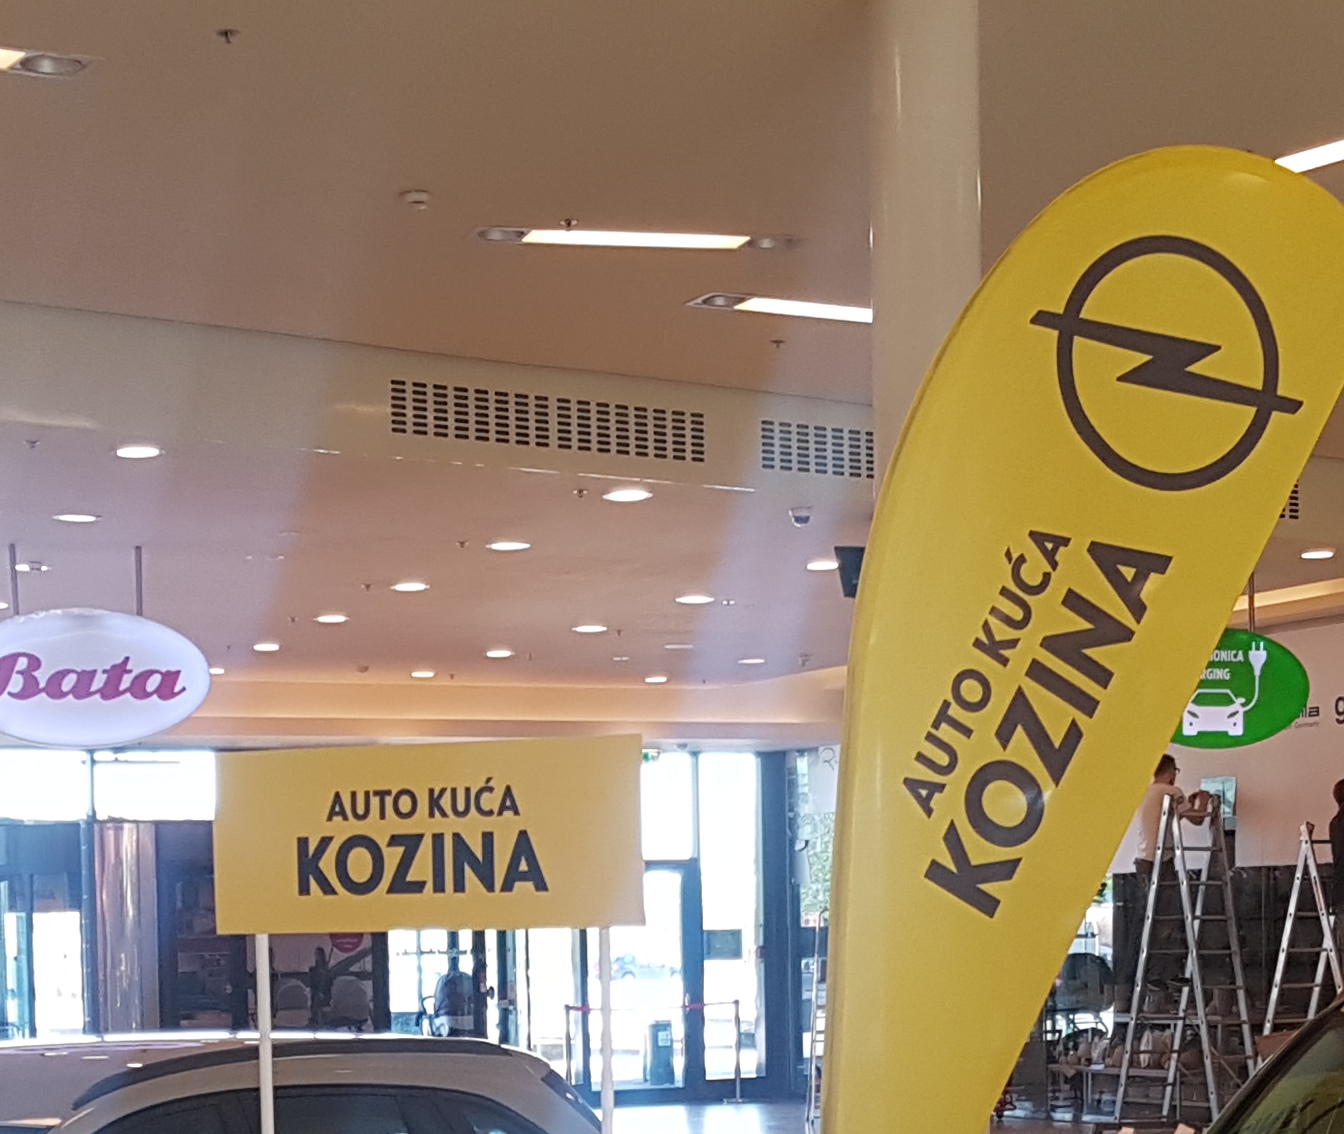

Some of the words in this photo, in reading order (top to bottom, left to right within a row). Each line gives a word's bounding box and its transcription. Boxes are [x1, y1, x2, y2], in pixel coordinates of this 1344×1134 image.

[903, 668, 992, 819] AUTO
[972, 529, 1072, 668] KUĆA
[1200, 668, 1230, 680] RGING
[1210, 649, 1244, 662] ONICA
[924, 540, 1174, 920] KOZINA
[325, 788, 419, 822] AUTO
[428, 776, 521, 819] KUĆA
[296, 829, 550, 897] KOZINA
